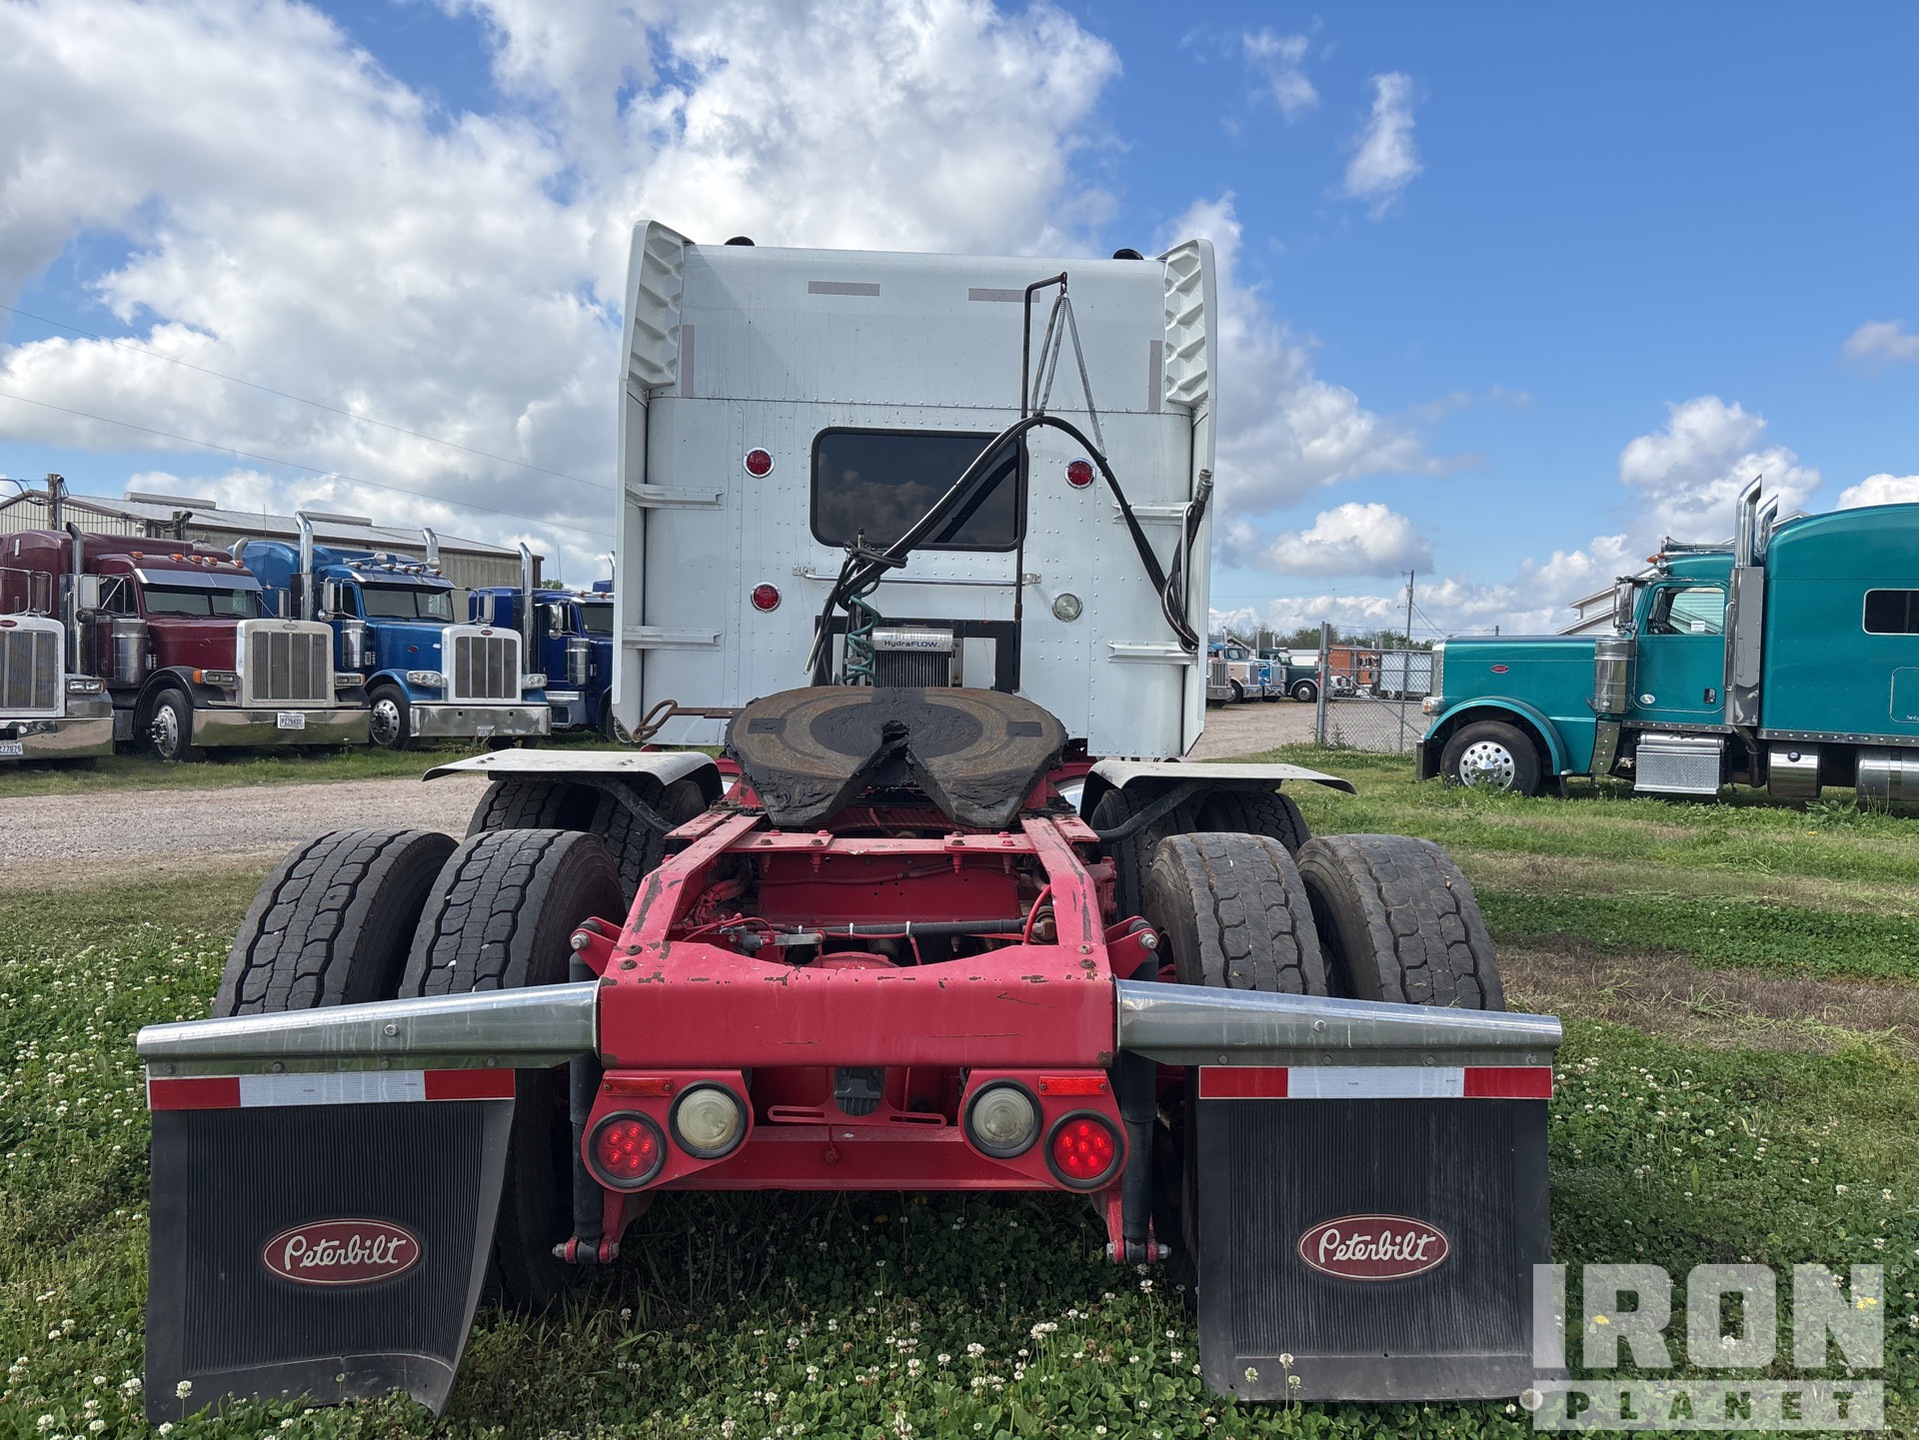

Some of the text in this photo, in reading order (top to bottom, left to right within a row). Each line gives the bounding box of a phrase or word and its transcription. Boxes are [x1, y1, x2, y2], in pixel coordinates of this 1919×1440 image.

[884, 640, 938, 648] HydraFLOW
[284, 1234, 407, 1271] Peterbilt
[1318, 1228, 1437, 1264] Peterbilt
